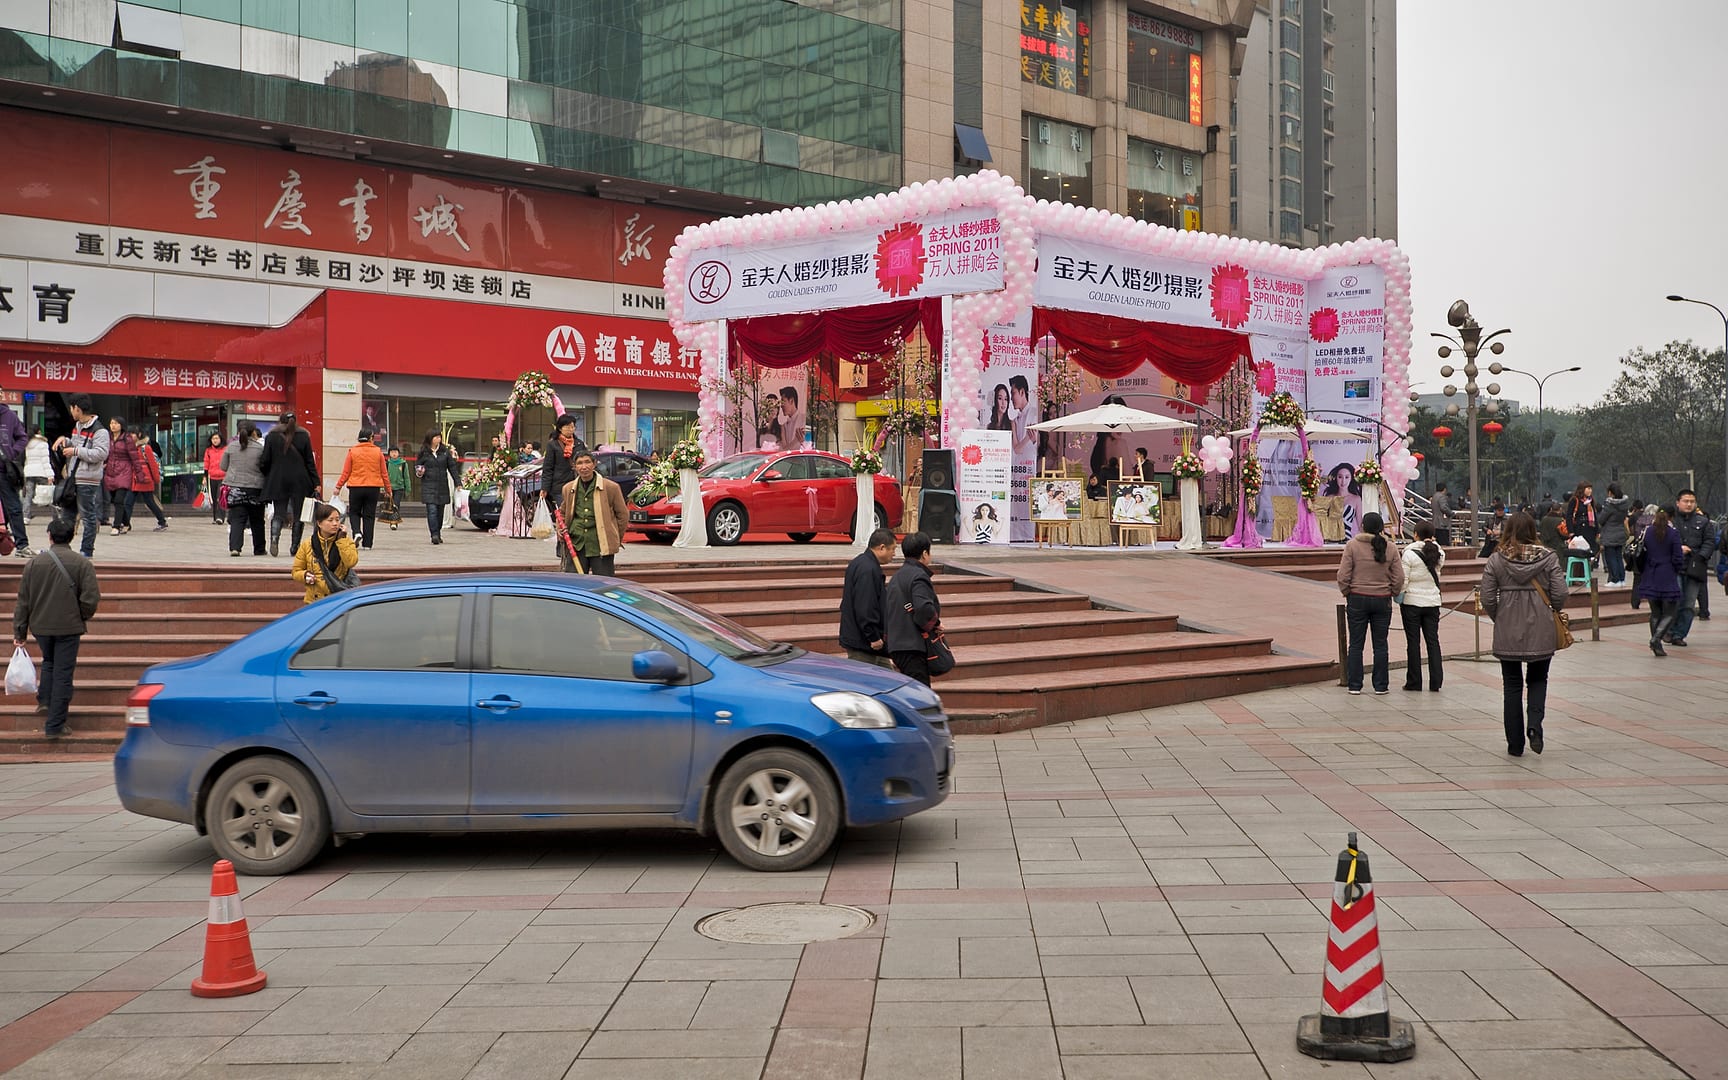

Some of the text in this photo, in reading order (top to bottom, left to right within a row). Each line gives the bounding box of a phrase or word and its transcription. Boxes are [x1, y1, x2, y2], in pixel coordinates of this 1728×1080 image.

[929, 218, 1001, 243] 金夫人婚纱摄影
[929, 236, 999, 258] SPRING 2011
[75, 231, 532, 299] 重庆新华书店集团沙坪坝连锁店
[741, 253, 869, 288] 金夫人婚纱摄影
[929, 251, 999, 278] 万人拼购会
[1053, 255, 1203, 299] 金夫人婚纱摄影
[1253, 276, 1305, 297] 金夫人婚纱摄影
[768, 283, 838, 299] GOLDEN LADIES PHOTO
[1088, 290, 1171, 311] GOLDEN LADIES PHOTO
[1253, 291, 1304, 309] SPRING 2011
[1253, 304, 1303, 326] 万人拼购会
[1341, 316, 1383, 326] SPRING 2011
[1341, 324, 1383, 336] 万人拼购会
[992, 345, 1019, 355] SPRING
[993, 354, 1036, 369] 万人拼购会
[594, 365, 698, 381] CHINA MERCHANTS BANK
